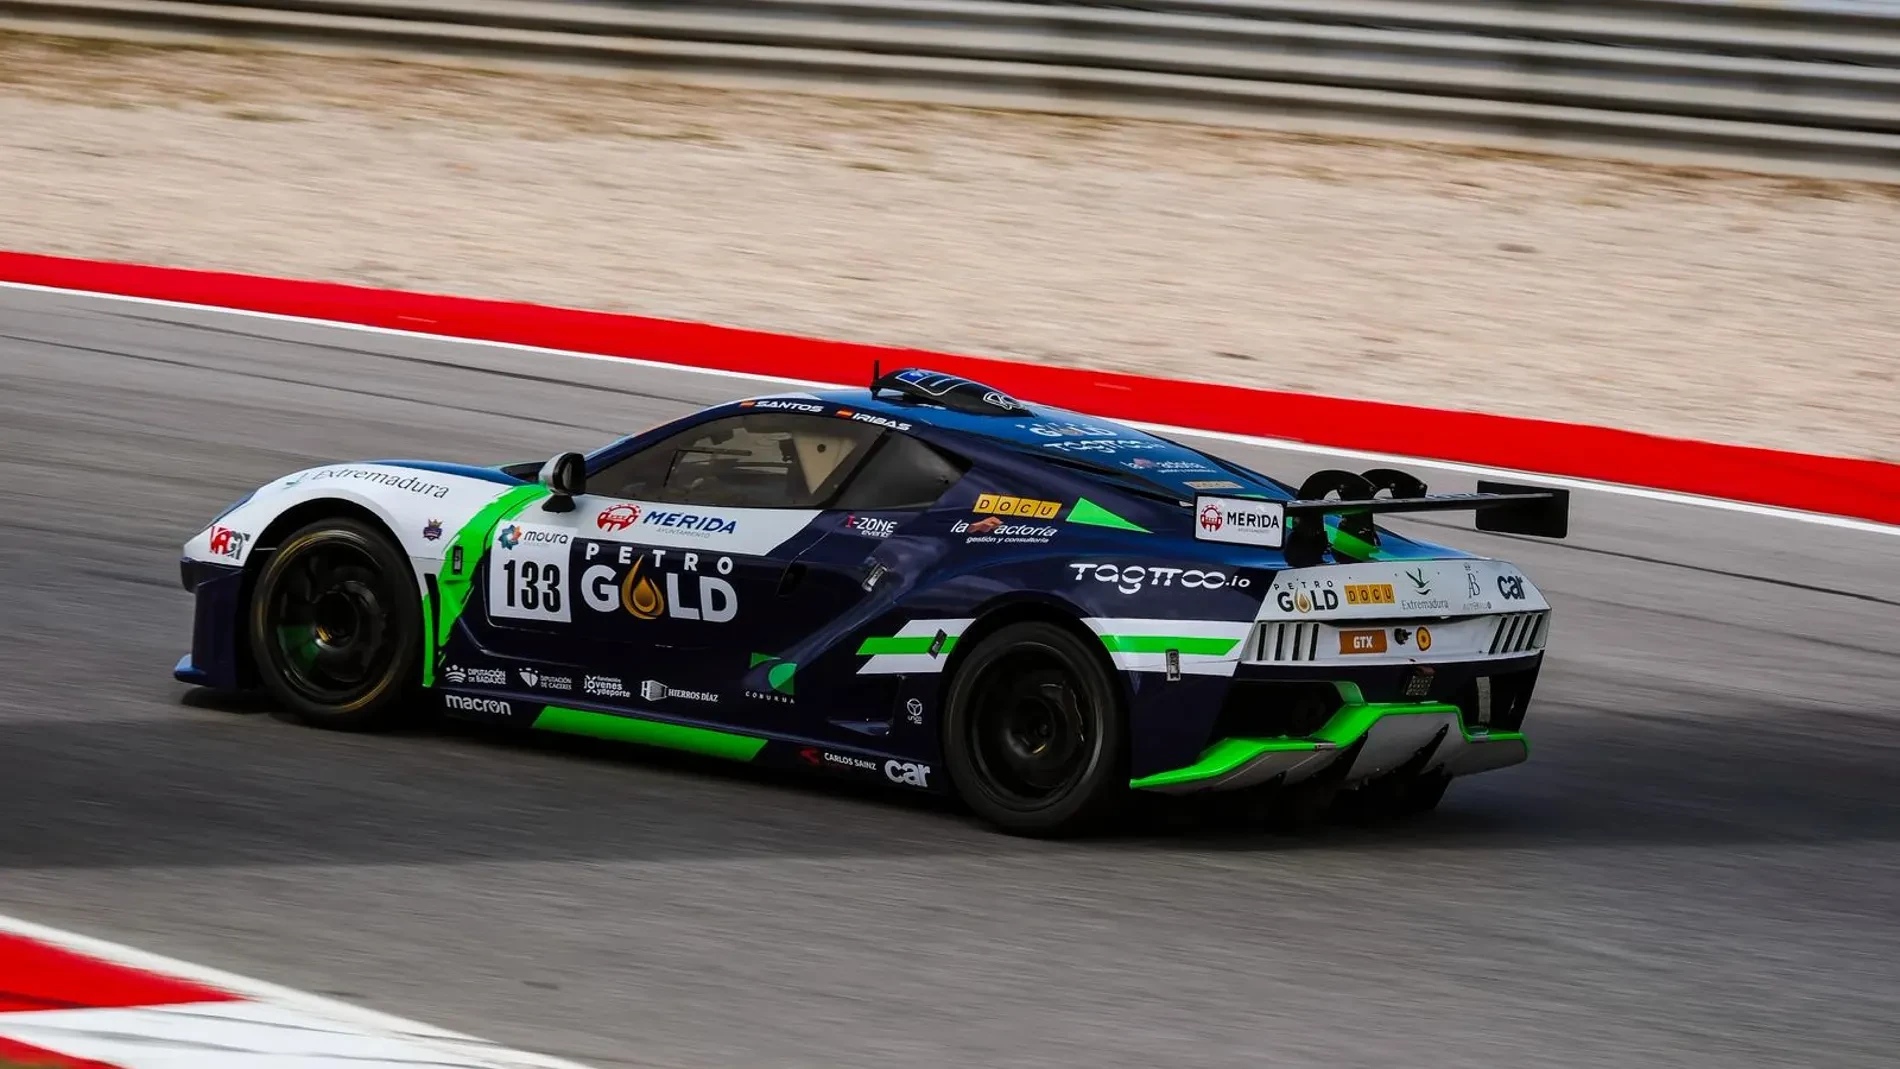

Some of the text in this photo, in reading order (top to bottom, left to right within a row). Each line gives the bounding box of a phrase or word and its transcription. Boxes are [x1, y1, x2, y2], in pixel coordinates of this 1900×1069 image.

[755, 400, 824, 413] SANTOS
[852, 412, 912, 431] IRIBAS
[312, 466, 449, 499] Extremadura
[978, 499, 1053, 516] DOCU
[524, 531, 568, 544] moura
[585, 543, 734, 575] PETRO
[503, 559, 561, 612] 133
[1273, 580, 1334, 590] PETRO
[1497, 575, 1525, 600] car
[1348, 588, 1391, 602] DOCU
[1401, 600, 1449, 610] Extremadura
[1353, 636, 1373, 649] GTX
[445, 694, 512, 716] macron
[824, 752, 853, 766] CARLOS
[854, 758, 877, 770] SAINZ
[884, 759, 931, 787] car
